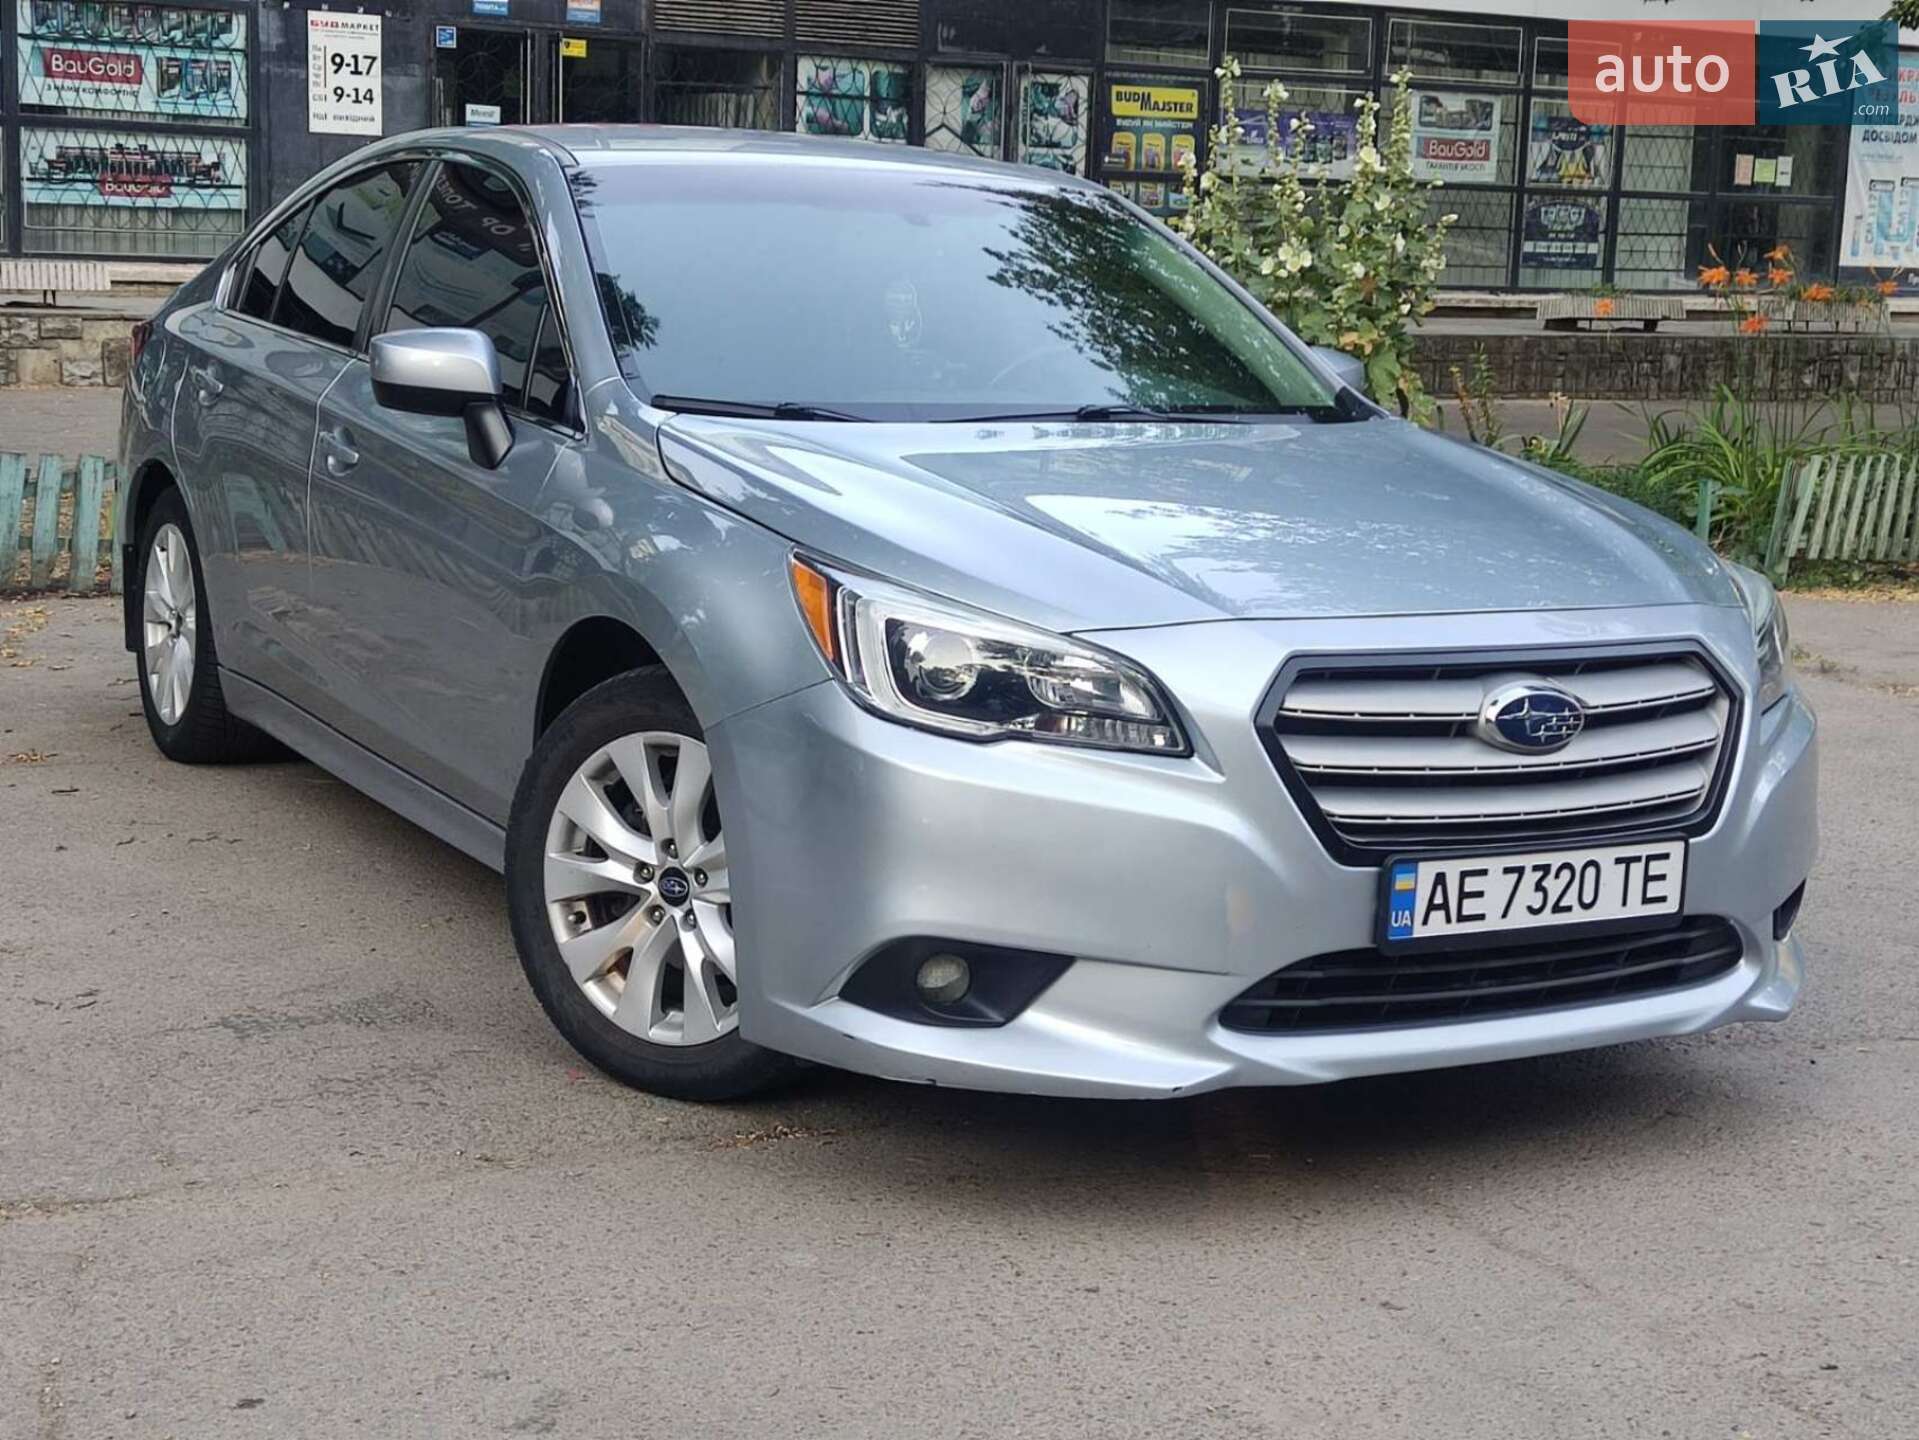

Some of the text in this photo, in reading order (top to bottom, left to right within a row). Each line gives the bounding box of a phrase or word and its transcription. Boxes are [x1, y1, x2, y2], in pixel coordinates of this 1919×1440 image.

[51, 53, 136, 78] BauGold
[330, 52, 378, 76] 9-17
[333, 86, 374, 105] 9-14
[1428, 139, 1487, 158] BauGold
[1421, 852, 1671, 927] AE 7320 TE
[1391, 910, 1412, 928] UA
